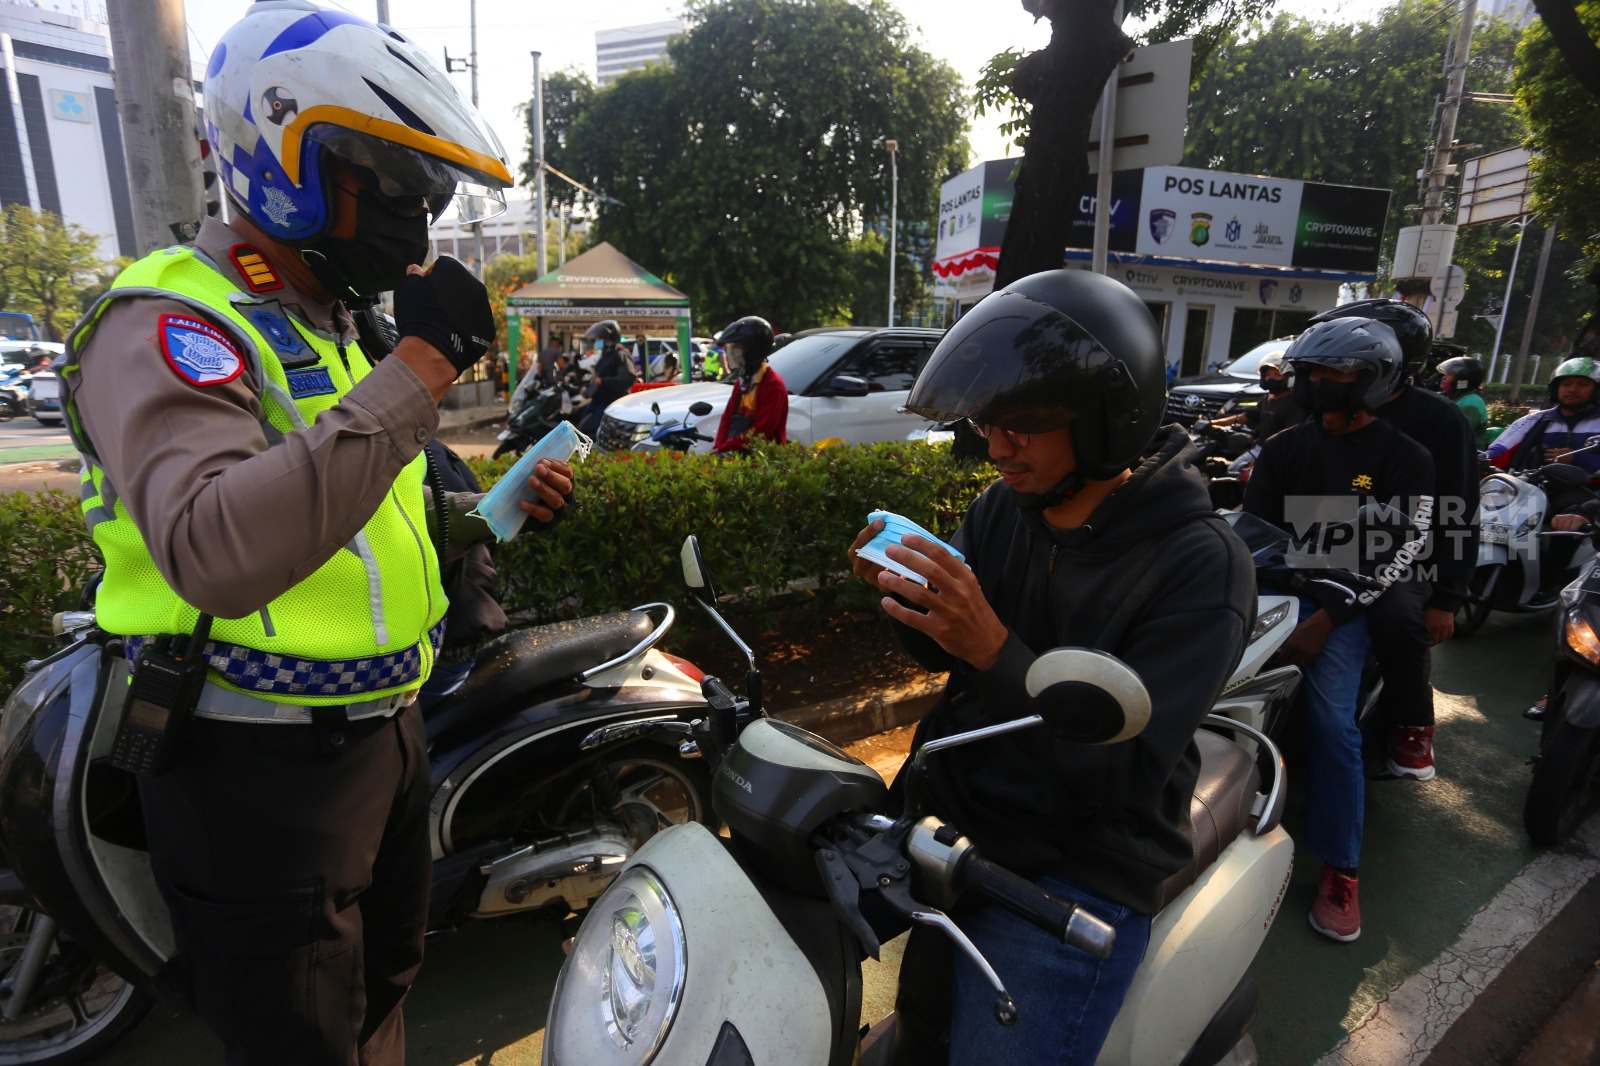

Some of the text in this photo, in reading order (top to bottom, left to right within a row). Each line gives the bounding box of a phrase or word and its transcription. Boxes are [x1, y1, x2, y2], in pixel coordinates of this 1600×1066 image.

[941, 185, 980, 215] POS LANTAS
[1164, 175, 1282, 204] POS LANTAS
[1135, 270, 1159, 284] triv
[616, 309, 647, 317] METRO
[1222, 676, 1252, 691] ONDA
[720, 763, 753, 794] HONDA
